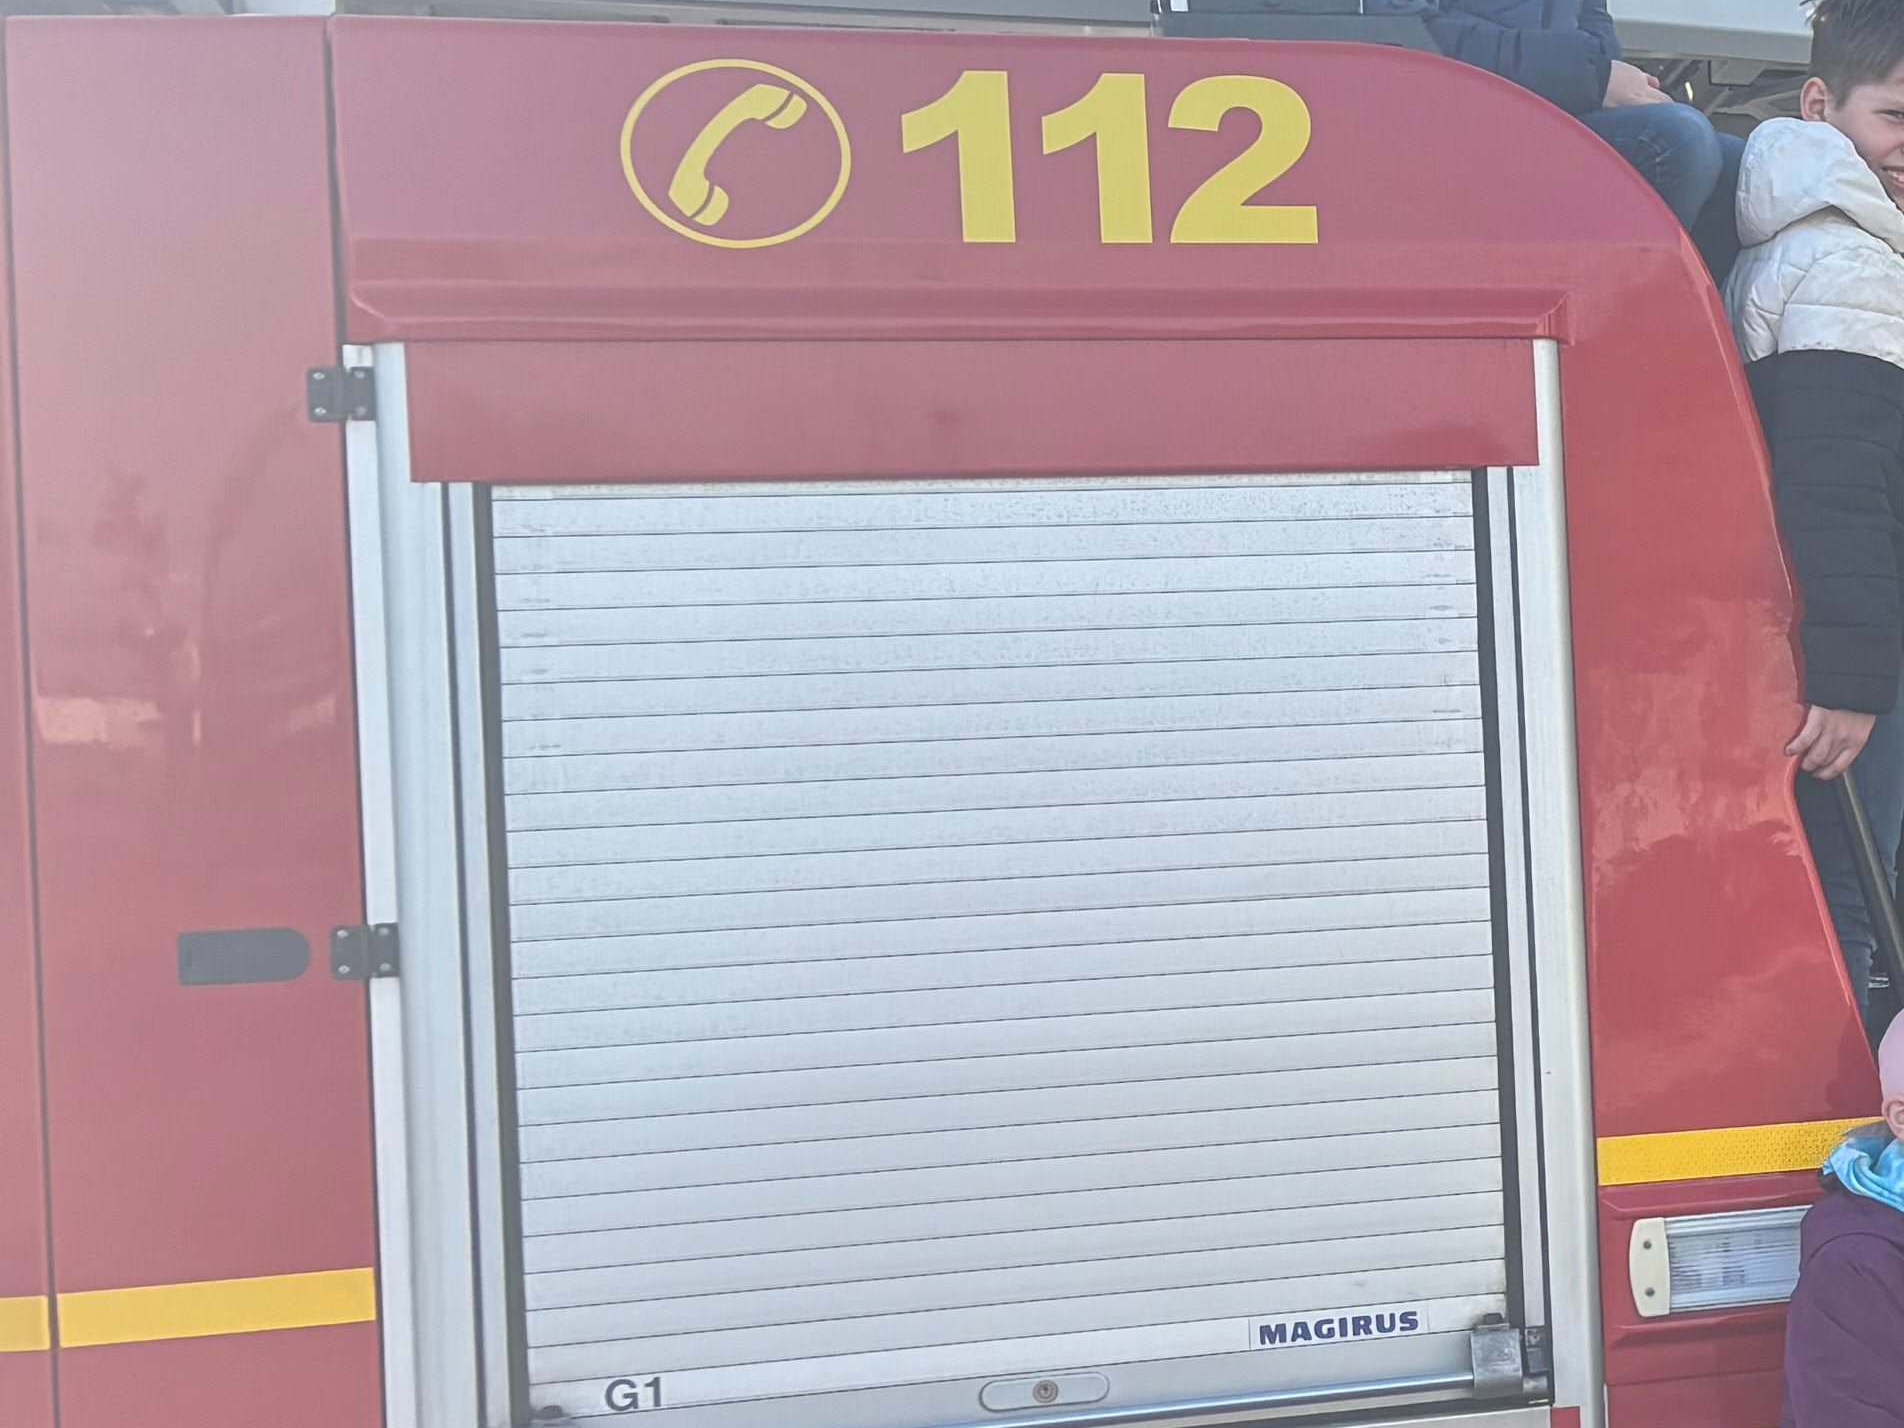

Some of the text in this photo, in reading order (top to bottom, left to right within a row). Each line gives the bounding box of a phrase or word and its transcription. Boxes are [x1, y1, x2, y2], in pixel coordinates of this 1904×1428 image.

[900, 70, 1320, 246] 112
[1259, 1311, 1419, 1345] MAGIRUS
[605, 1376, 663, 1412] G1
